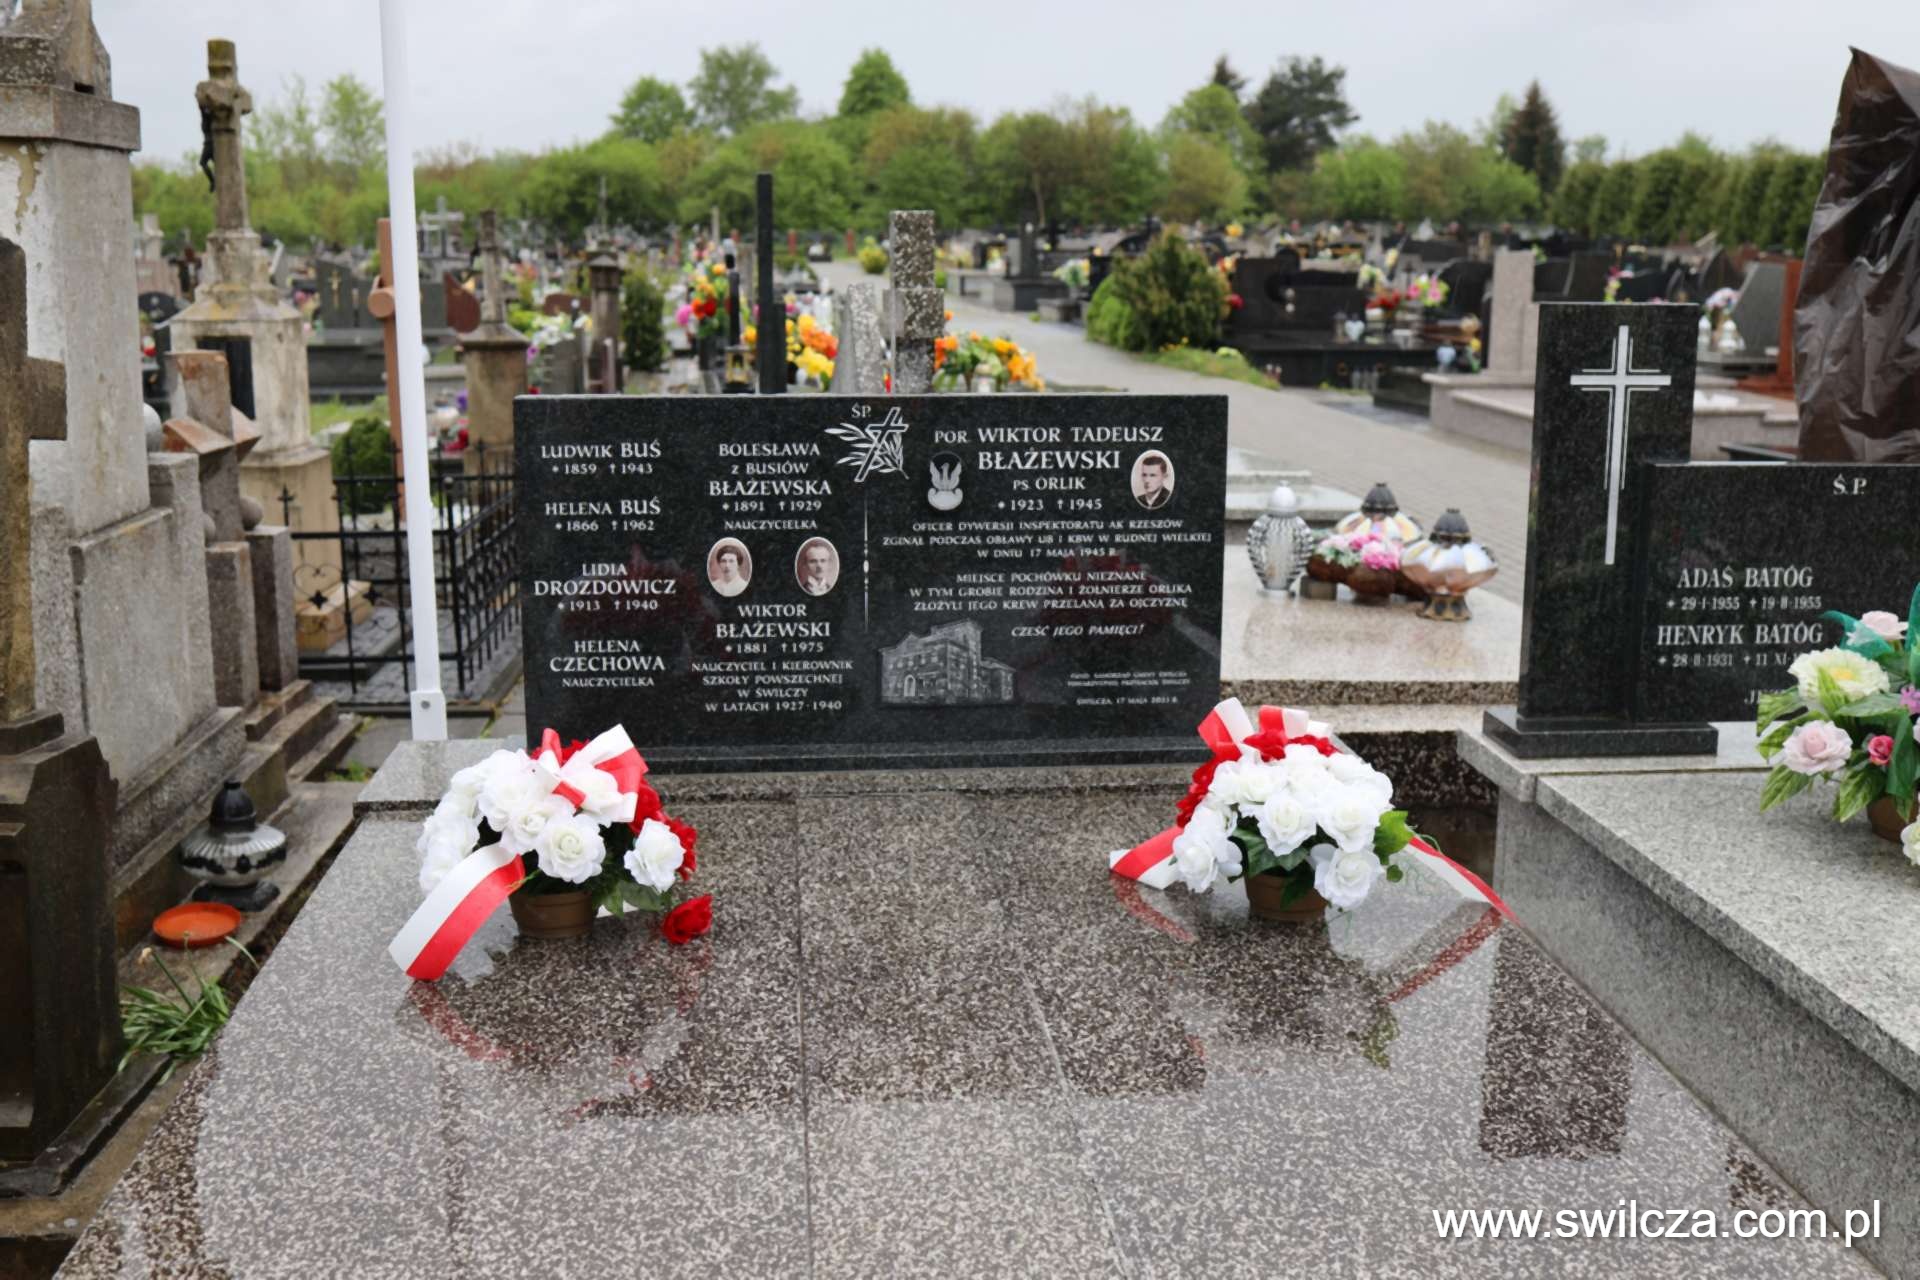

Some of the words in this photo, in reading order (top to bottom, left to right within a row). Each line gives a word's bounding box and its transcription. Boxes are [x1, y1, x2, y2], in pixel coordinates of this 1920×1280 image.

[977, 427, 1061, 443] WIKTOR
[1070, 426, 1163, 443] TADEUSZ
[541, 444, 613, 459] LUDWIK
[620, 438, 662, 458] BUŚ
[719, 443, 820, 456] BOLESŁAWA
[978, 447, 1121, 470] BŁAŻEWSKI
[564, 463, 597, 474] 1859
[621, 463, 653, 474] 1943
[746, 460, 809, 475] BUSIÓW
[709, 478, 832, 496] BŁAŻEWSKA
[1035, 476, 1086, 490] ORLIK
[545, 502, 612, 515] HELENA
[620, 496, 661, 515] BUŚ
[734, 501, 765, 512] 1891
[790, 500, 822, 511] 1929
[1011, 499, 1044, 511] 1923
[1070, 498, 1102, 510] 1945
[566, 521, 599, 531] 1866
[623, 520, 655, 531] 1962
[724, 519, 817, 530] NAUCZYCIELKA
[912, 522, 953, 532] OFICER
[1019, 520, 1104, 531] INSPEKTORATU
[1109, 520, 1124, 529] AK
[1129, 518, 1183, 529] RZESZÓW
[929, 535, 981, 545] PODCZAS
[986, 535, 1033, 544] OBŁAWY
[1115, 533, 1157, 543] RUDNEJ
[1162, 532, 1212, 542] WIELKIEJ
[977, 549, 989, 558] W
[994, 549, 1023, 558] DNIU
[1046, 549, 1074, 557] MAJA
[1080, 548, 1105, 556] 1945
[582, 563, 628, 576] LIDIA
[956, 573, 1005, 583] MIEJSCE
[1011, 571, 1081, 582] POCHÓWKU
[1087, 572, 1147, 581] NIEZNANE
[1677, 565, 1734, 588] ADAŚ
[1744, 565, 1813, 588] BATÓG
[534, 580, 677, 596] DROZDOWICZ
[909, 588, 922, 597] W
[927, 587, 953, 597] TYM
[958, 587, 1003, 597] GROBIE
[1009, 586, 1063, 596] RODZINA
[1078, 585, 1143, 595] ŻOŁNIERZE
[1149, 584, 1192, 593] ORLIKA
[570, 600, 600, 611] 1913
[626, 599, 658, 610] 1940
[738, 604, 807, 617] WIKTOR
[914, 600, 962, 611] ZŁOŻYLI
[968, 600, 997, 611] JEGO
[1002, 599, 1039, 610] KREW
[1109, 598, 1125, 608] ZA
[716, 621, 831, 638] BŁAŻEWSKI
[1011, 625, 1050, 637] CZEŚĆ
[1053, 625, 1084, 638] JEGO
[1088, 623, 1145, 637] PAMIĘCI!
[1657, 625, 1744, 646] HENRYK
[1755, 621, 1823, 644] BATÓG
[574, 640, 640, 653] HELENA
[736, 643, 767, 654] 1881
[792, 642, 824, 653] 1975
[549, 656, 665, 672] CZECHOWA
[691, 661, 766, 672] NAUCZYCIEL
[782, 660, 854, 670] KIEROWNIK
[562, 677, 655, 687] NAUCZYCIELKA
[702, 675, 749, 686] SZKOŁY
[755, 673, 843, 685] POWSZECHNEJ
[737, 690, 749, 698] W
[755, 687, 808, 698] ŚWILCZY
[705, 703, 718, 712] W
[723, 702, 769, 712] LATACH
